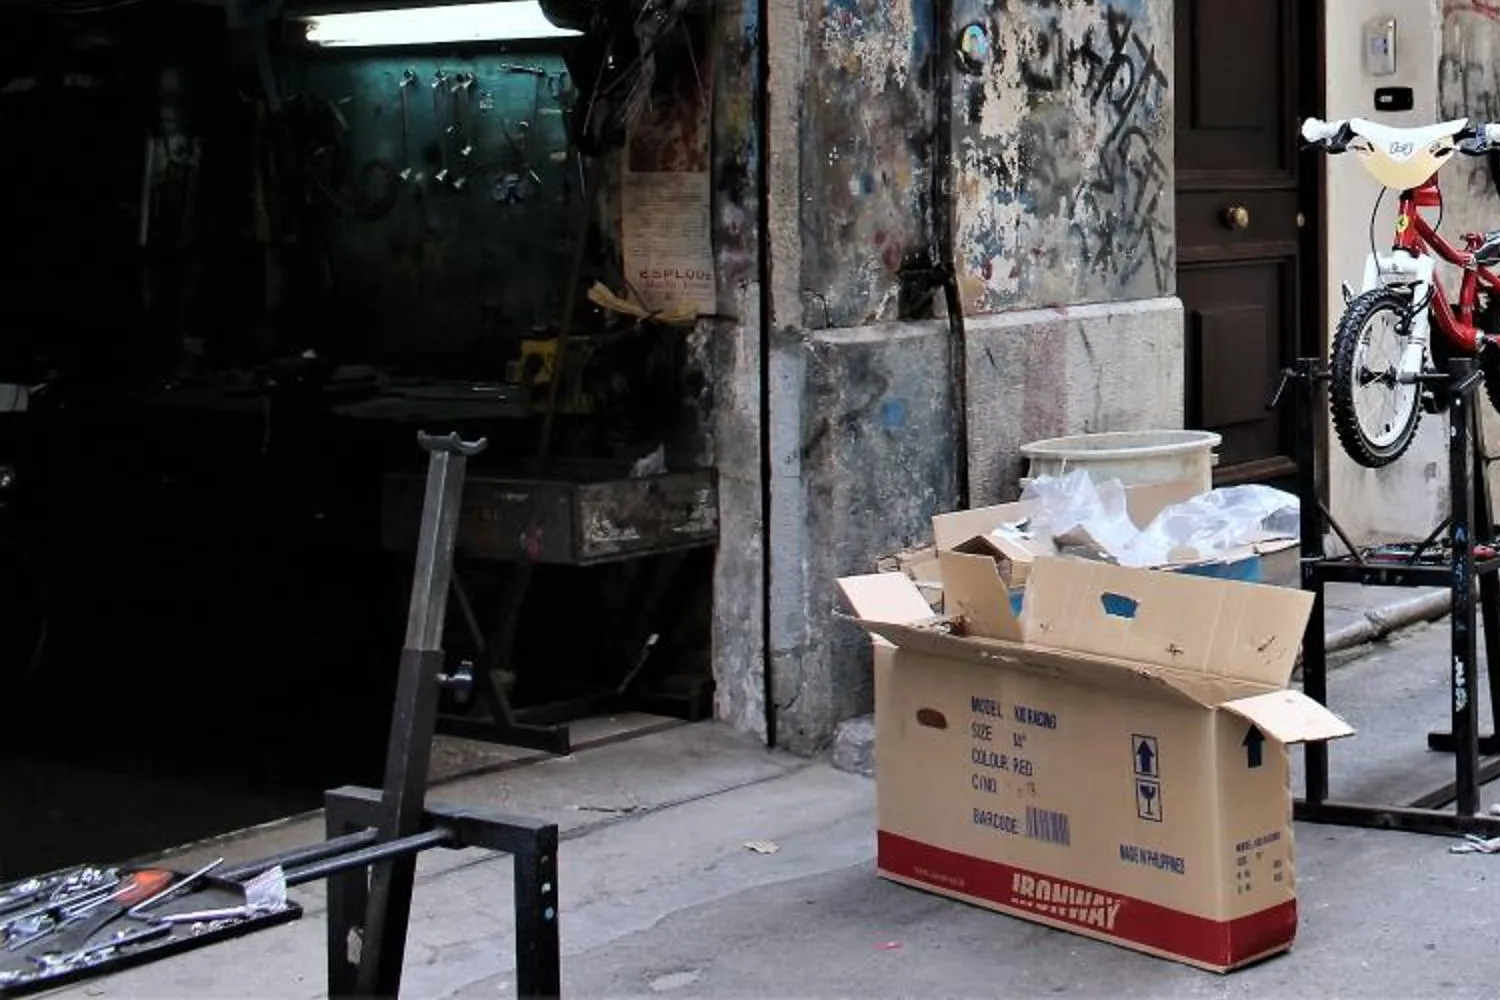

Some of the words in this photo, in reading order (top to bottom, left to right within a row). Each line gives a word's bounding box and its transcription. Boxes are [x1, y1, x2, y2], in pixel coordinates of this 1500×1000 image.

[971, 695, 1003, 719] MODEL
[971, 721, 993, 741] SIZE
[1013, 757, 1033, 777] RED
[1011, 873, 1122, 929] IRONWAY
